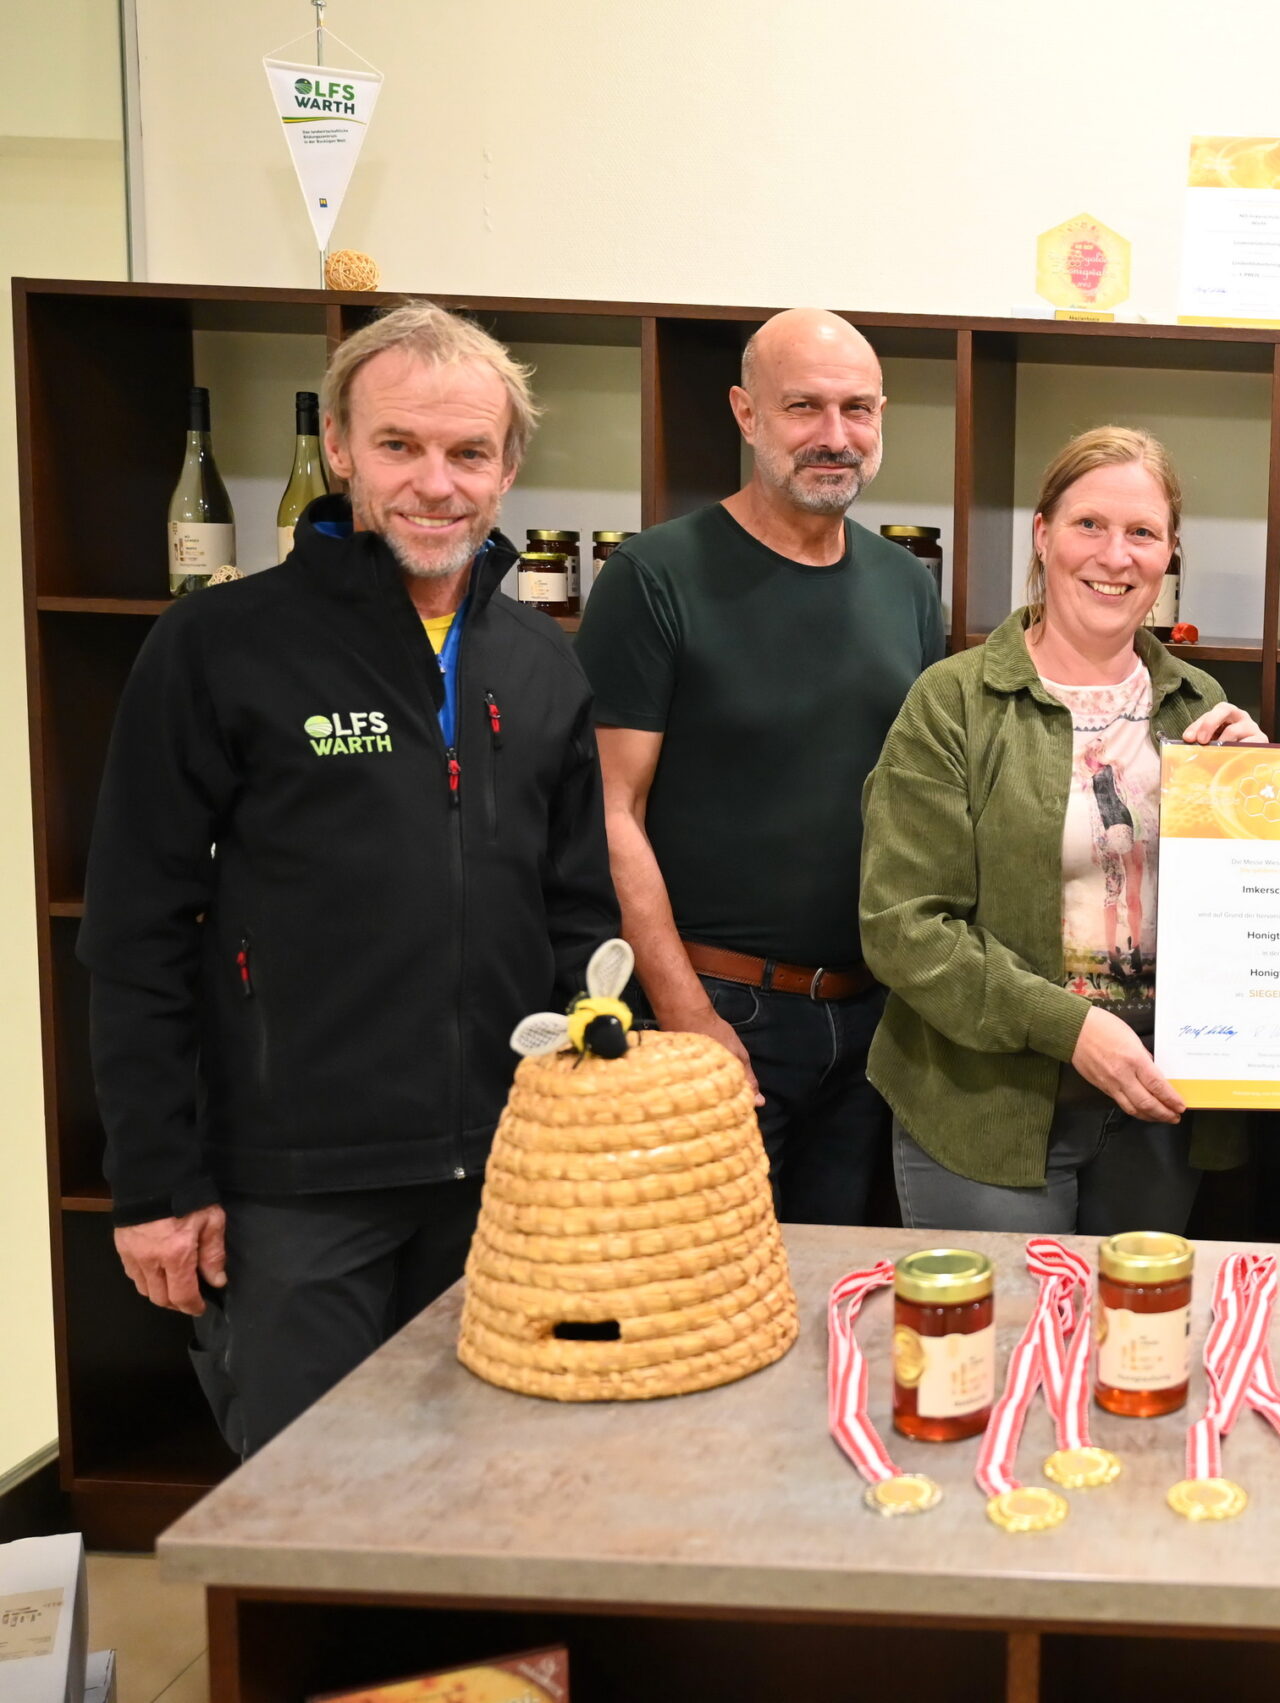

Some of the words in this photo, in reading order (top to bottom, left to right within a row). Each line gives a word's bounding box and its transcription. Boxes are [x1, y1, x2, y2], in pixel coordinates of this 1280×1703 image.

[314, 80, 355, 101] LFS
[294, 95, 355, 115] WARTH
[332, 711, 388, 736] LFS
[309, 734, 392, 757] WARTH
[1243, 858, 1263, 866] Messe
[1224, 911, 1243, 919] Grund
